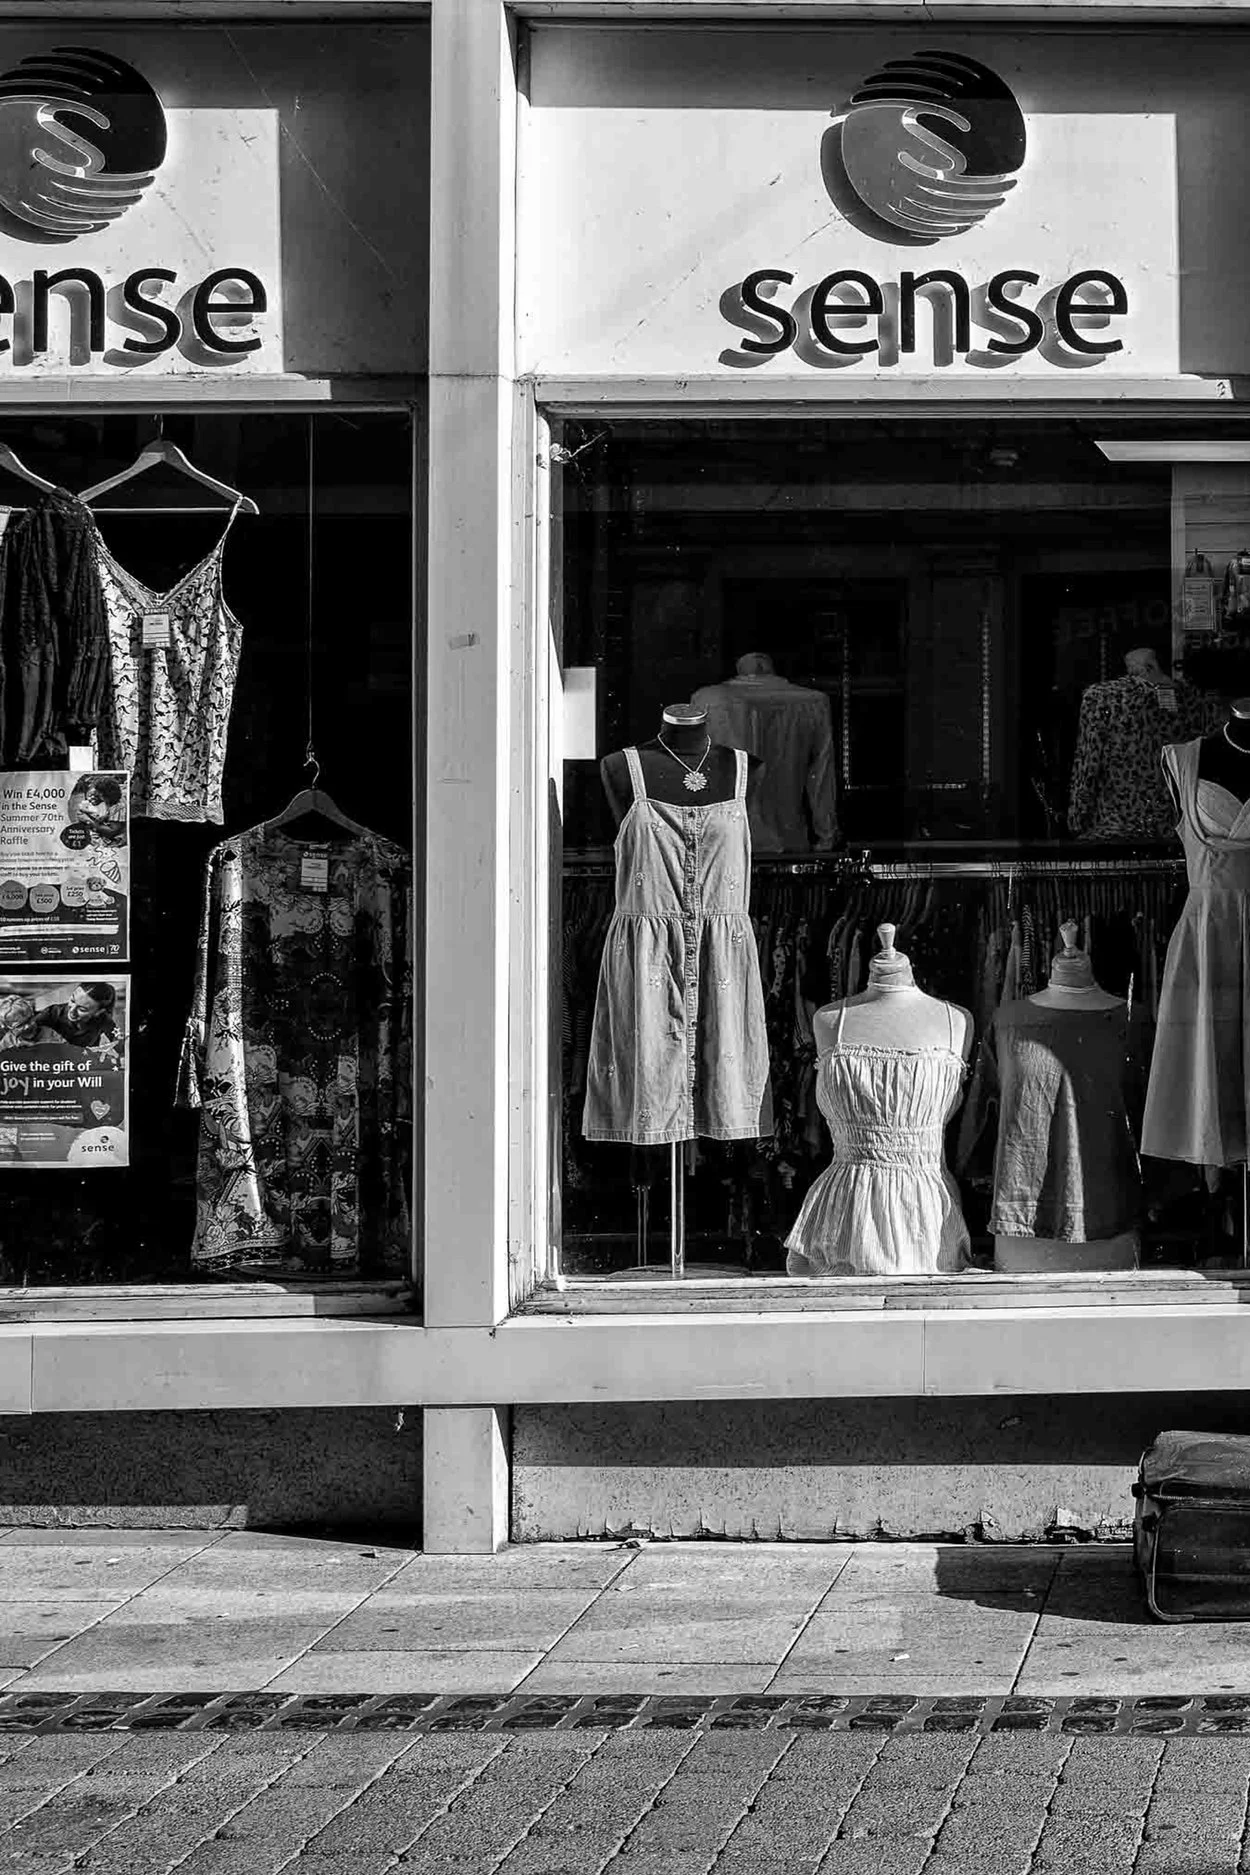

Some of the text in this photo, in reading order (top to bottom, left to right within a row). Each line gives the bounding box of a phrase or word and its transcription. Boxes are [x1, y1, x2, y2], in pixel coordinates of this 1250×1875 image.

[0, 267, 267, 353] nse
[740, 269, 1128, 355] sense
[3, 788, 65, 800] Win £4,000
[1, 802, 57, 810] in the Sense
[0, 813, 64, 822] Summer 70th
[0, 825, 55, 835] Anniversary
[0, 836, 28, 845] Raffle
[80, 945, 105, 953] sense
[0, 1060, 92, 1074] Give the gift of
[0, 1072, 102, 1096] joy in your Will
